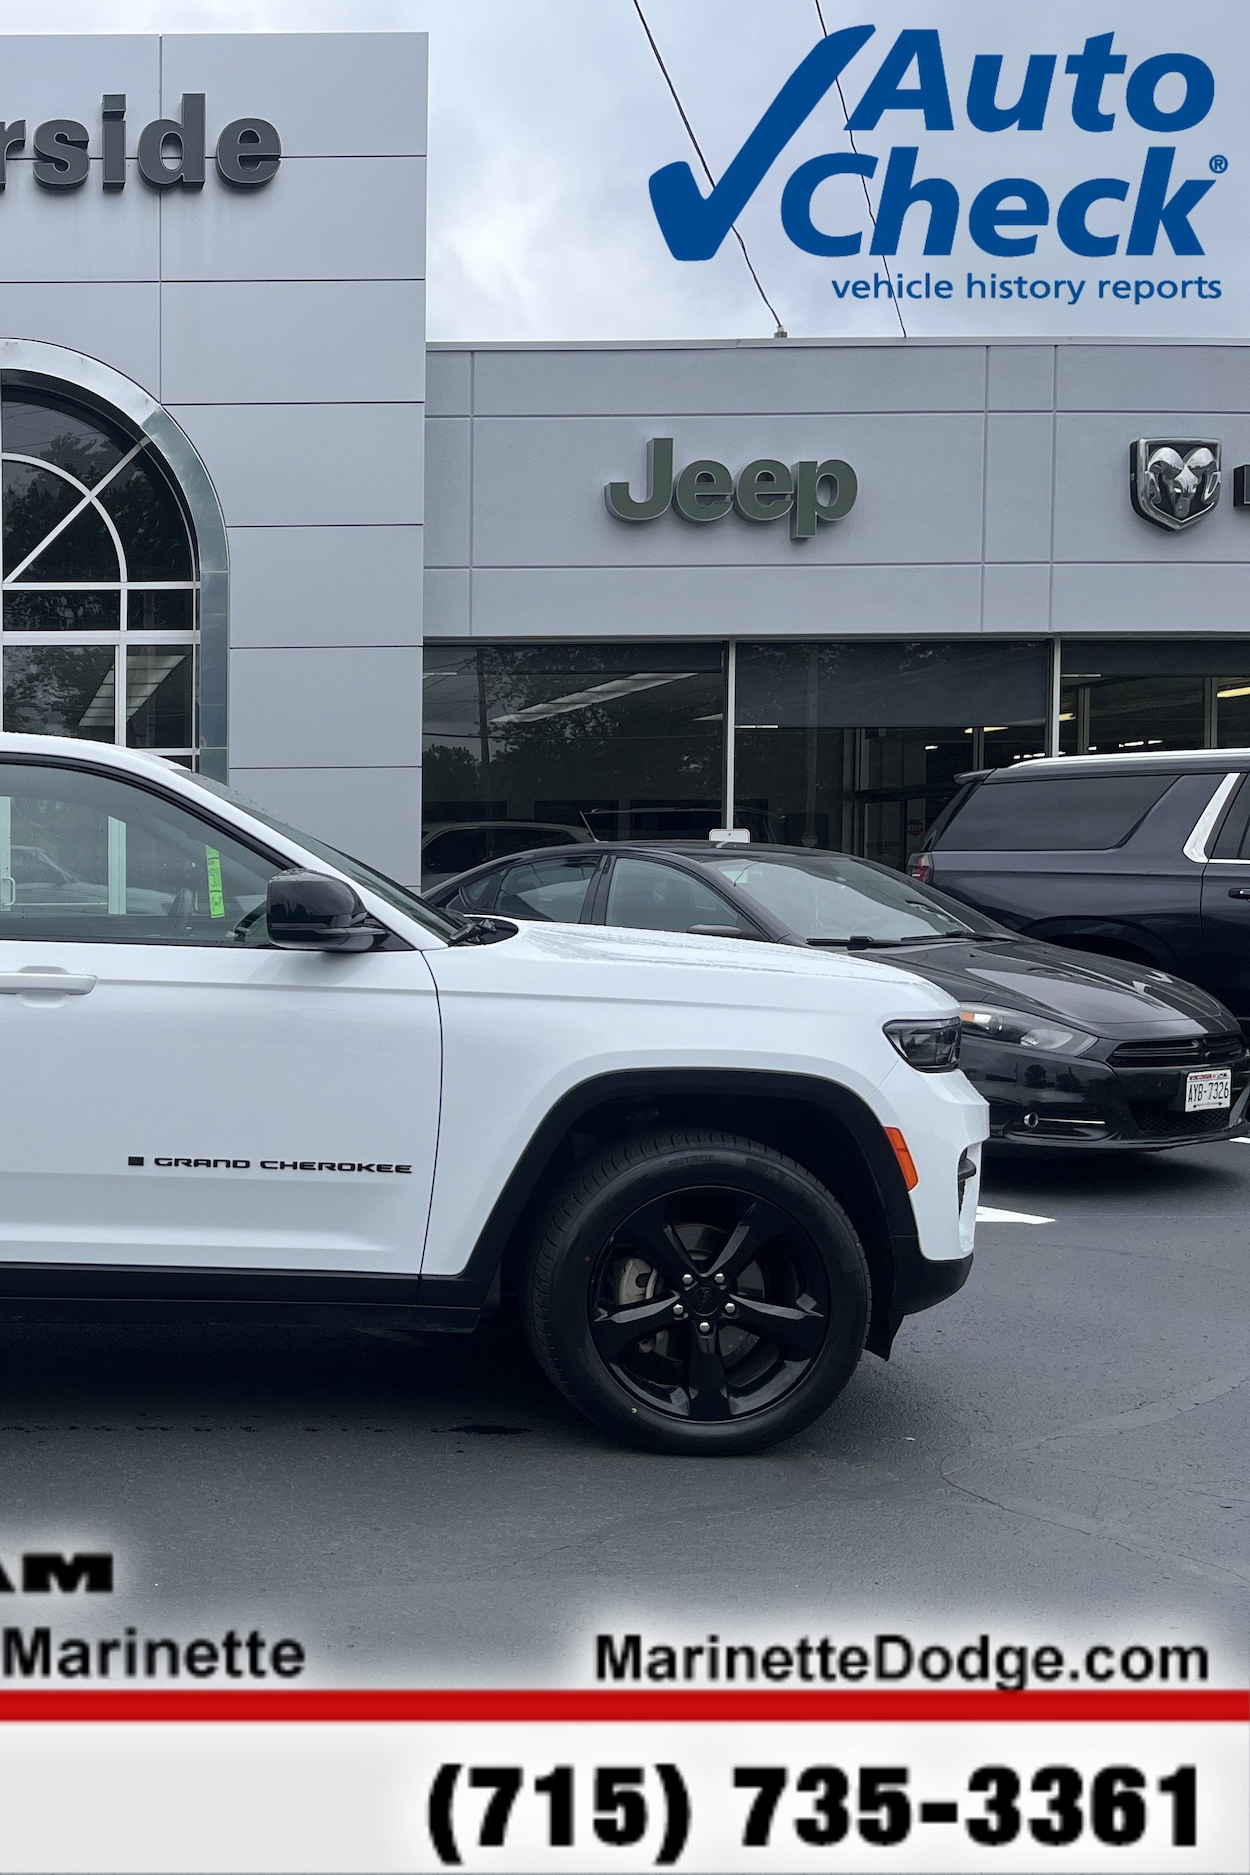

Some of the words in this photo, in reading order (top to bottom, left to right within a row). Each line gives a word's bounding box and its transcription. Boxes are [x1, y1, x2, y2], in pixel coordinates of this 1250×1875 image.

[604, 437, 859, 540] Jeep
[1188, 1081, 1230, 1103] AYB-7326
[154, 1157, 251, 1169] GRAND
[260, 1160, 413, 1174] CHEROKEE
